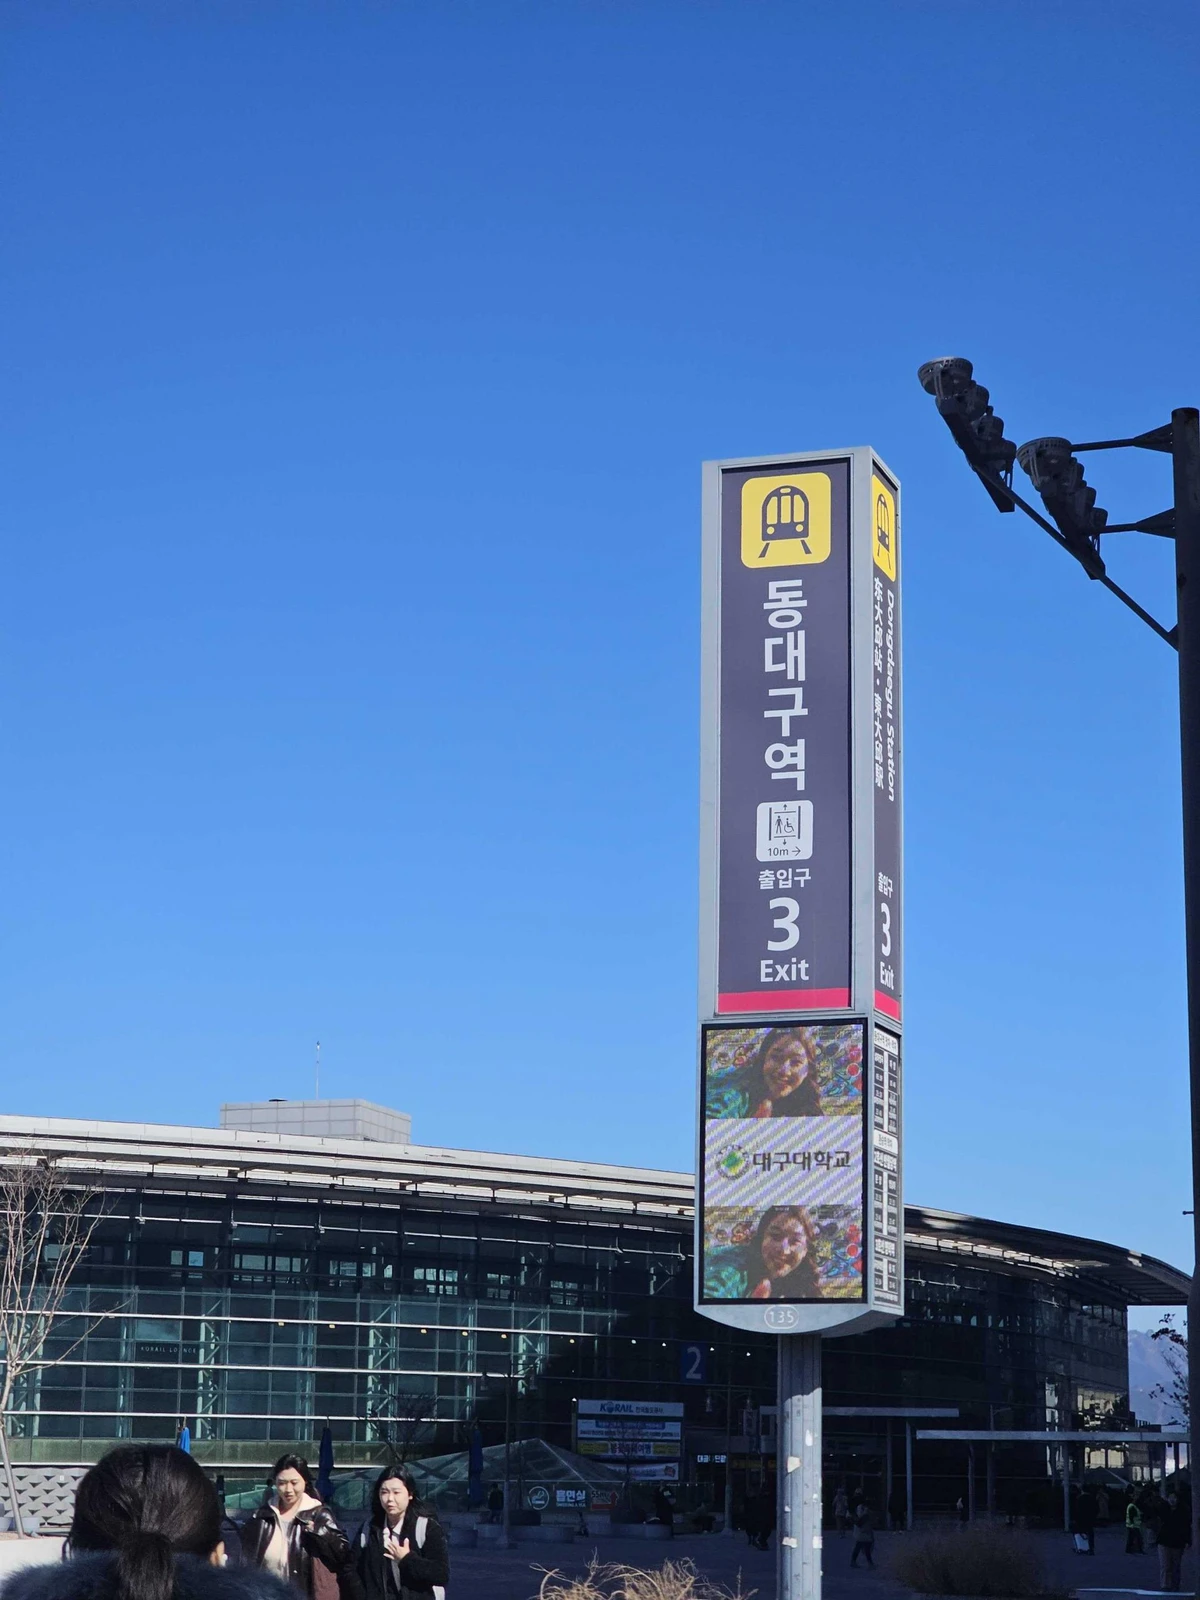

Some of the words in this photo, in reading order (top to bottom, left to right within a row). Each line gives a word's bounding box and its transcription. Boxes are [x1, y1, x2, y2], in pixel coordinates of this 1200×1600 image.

[885, 589, 895, 719] Dongdaegu
[763, 579, 809, 791] 동대구역
[886, 723, 896, 802] Station
[767, 847, 789, 856] 10m
[758, 868, 812, 889] 출입구
[877, 872, 894, 898] 출입구
[767, 897, 800, 952] 3
[881, 902, 891, 957] 3
[760, 958, 810, 982] Exit
[880, 961, 895, 990] Exit
[752, 1149, 851, 1172] 대구대학교
[768, 1311, 795, 1323] 135
[685, 1346, 702, 1380] 2
